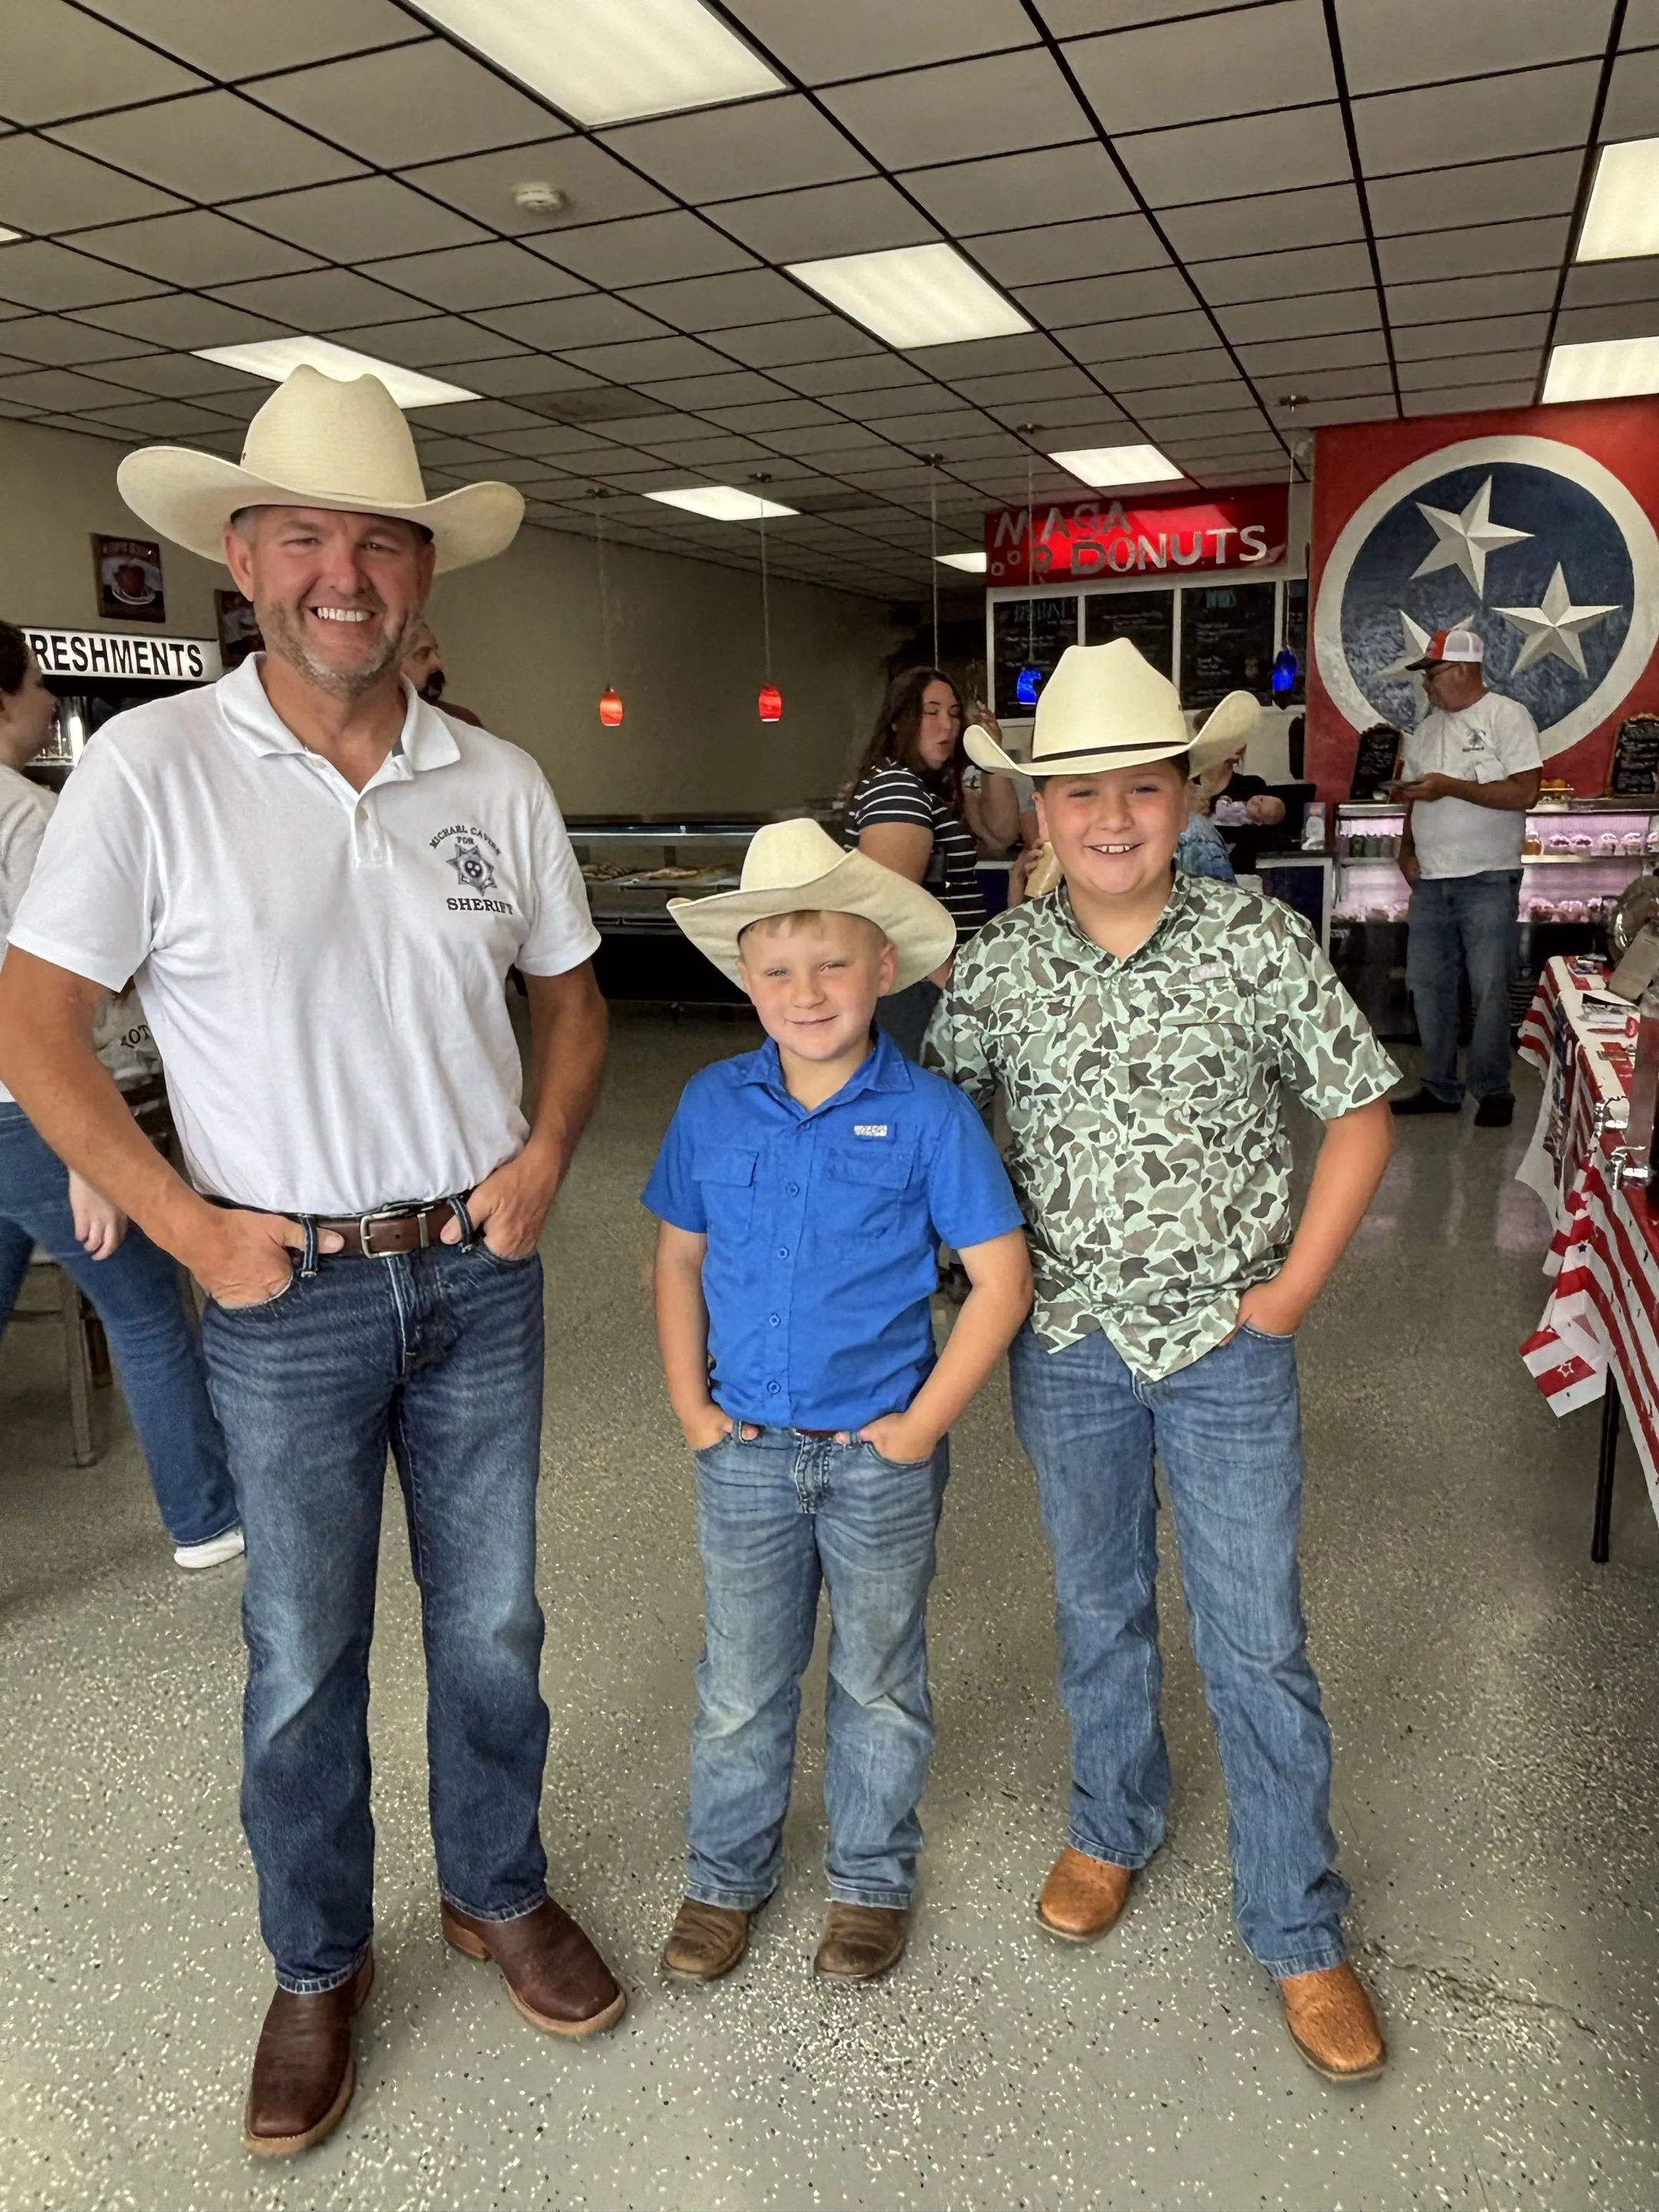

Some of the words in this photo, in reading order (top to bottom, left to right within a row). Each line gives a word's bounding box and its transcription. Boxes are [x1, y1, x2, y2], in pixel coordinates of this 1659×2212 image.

[1071, 525, 1267, 575] DONUTS
[23, 633, 204, 677] RESHMENTS
[456, 836, 475, 845] FOR
